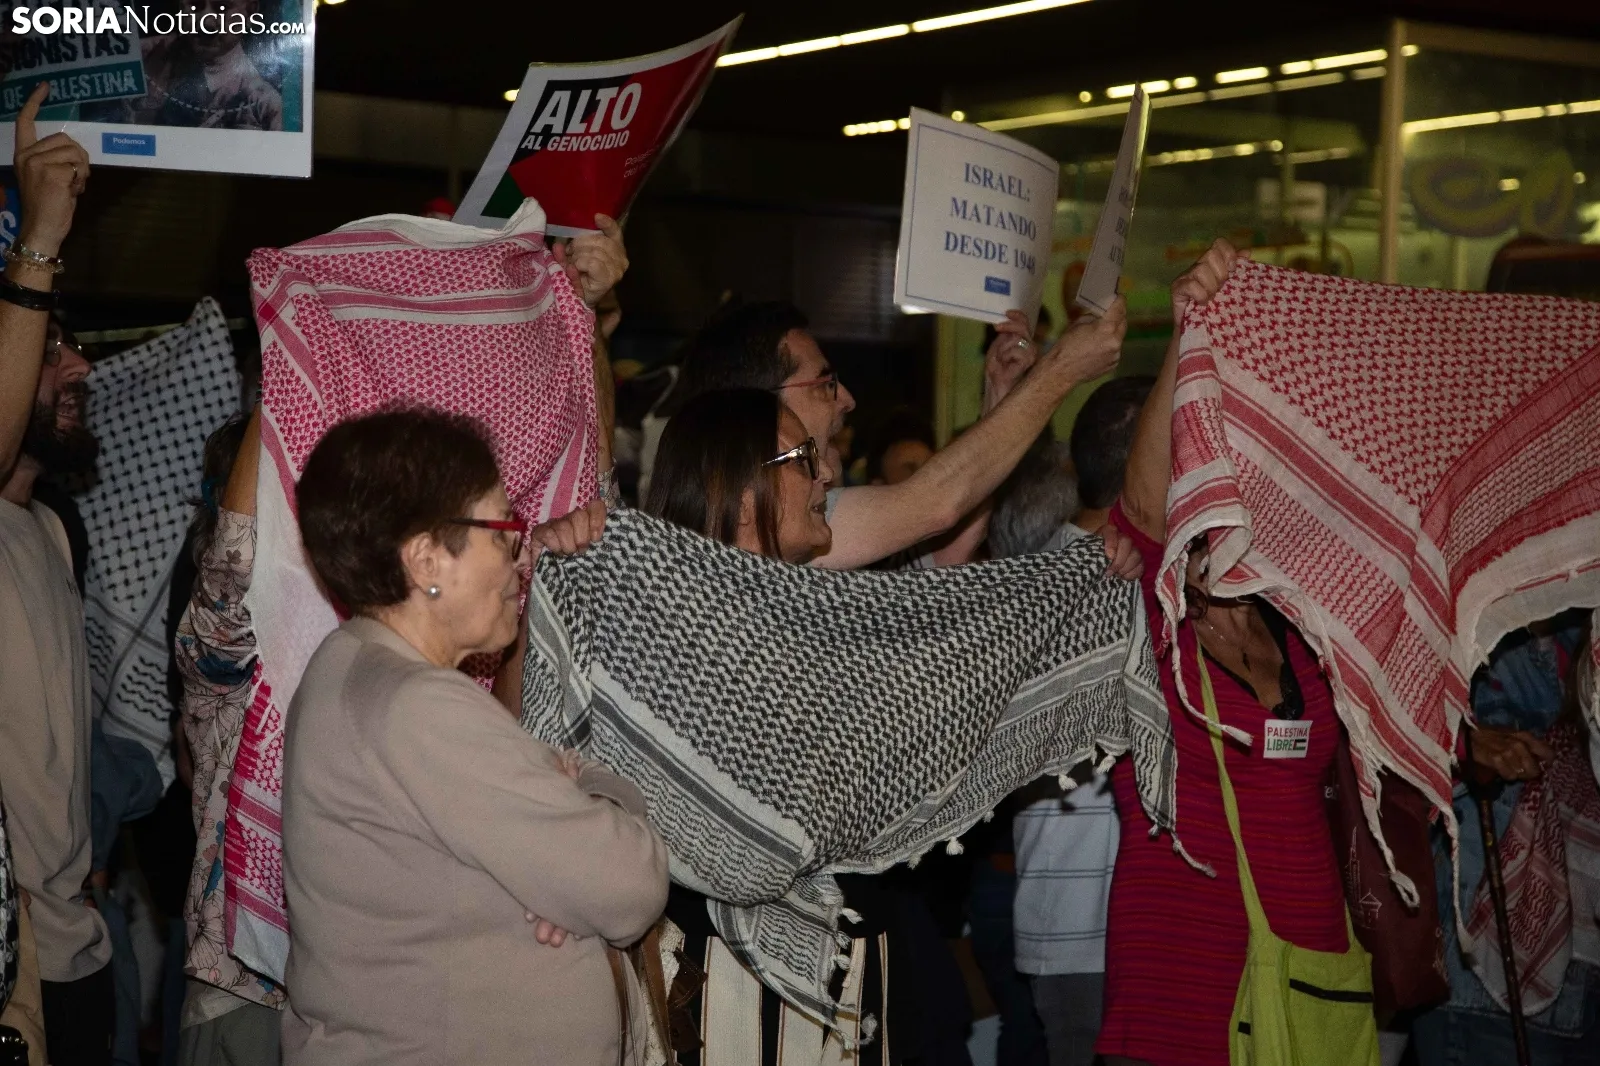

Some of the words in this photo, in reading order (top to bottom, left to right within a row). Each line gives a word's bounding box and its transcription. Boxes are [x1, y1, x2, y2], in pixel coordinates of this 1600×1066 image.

[3, 84, 25, 110] DE
[36, 69, 138, 102] ALESTINA
[529, 82, 642, 134] ALTO
[112, 137, 146, 146] Podemos
[521, 134, 544, 150] AL
[546, 129, 630, 152] GENOCIDIO
[964, 162, 1031, 203] ISRAEL:
[950, 196, 1037, 242] MATANDO
[943, 230, 1009, 265] DESDE
[1266, 738, 1293, 751] LIBRE
[1267, 727, 1308, 738] PALESTINA
